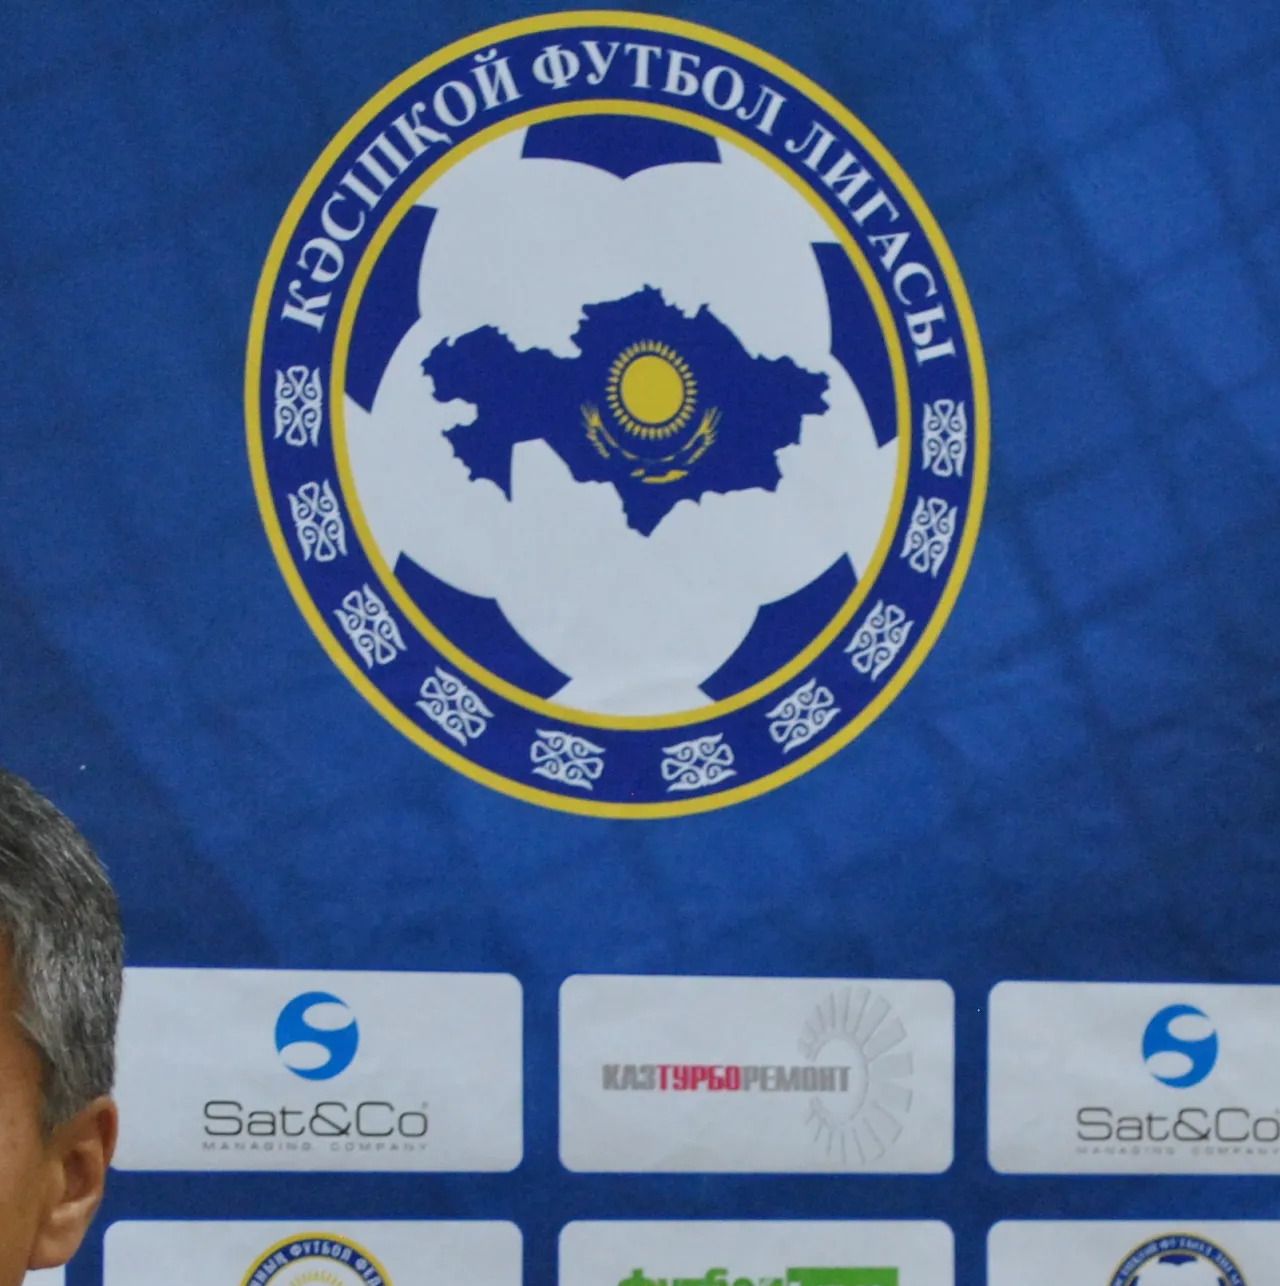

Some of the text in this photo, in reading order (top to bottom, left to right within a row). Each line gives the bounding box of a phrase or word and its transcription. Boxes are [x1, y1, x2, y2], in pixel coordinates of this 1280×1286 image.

[532, 39, 786, 135] ФУТБОЛ
[784, 117, 957, 366] ЛИГАСЫ
[602, 1064, 852, 1092] КАЗТУРБОРЕМОНТ
[204, 1100, 428, 1137] Sat&Co
[1076, 1106, 1280, 1142] Sat&Co
